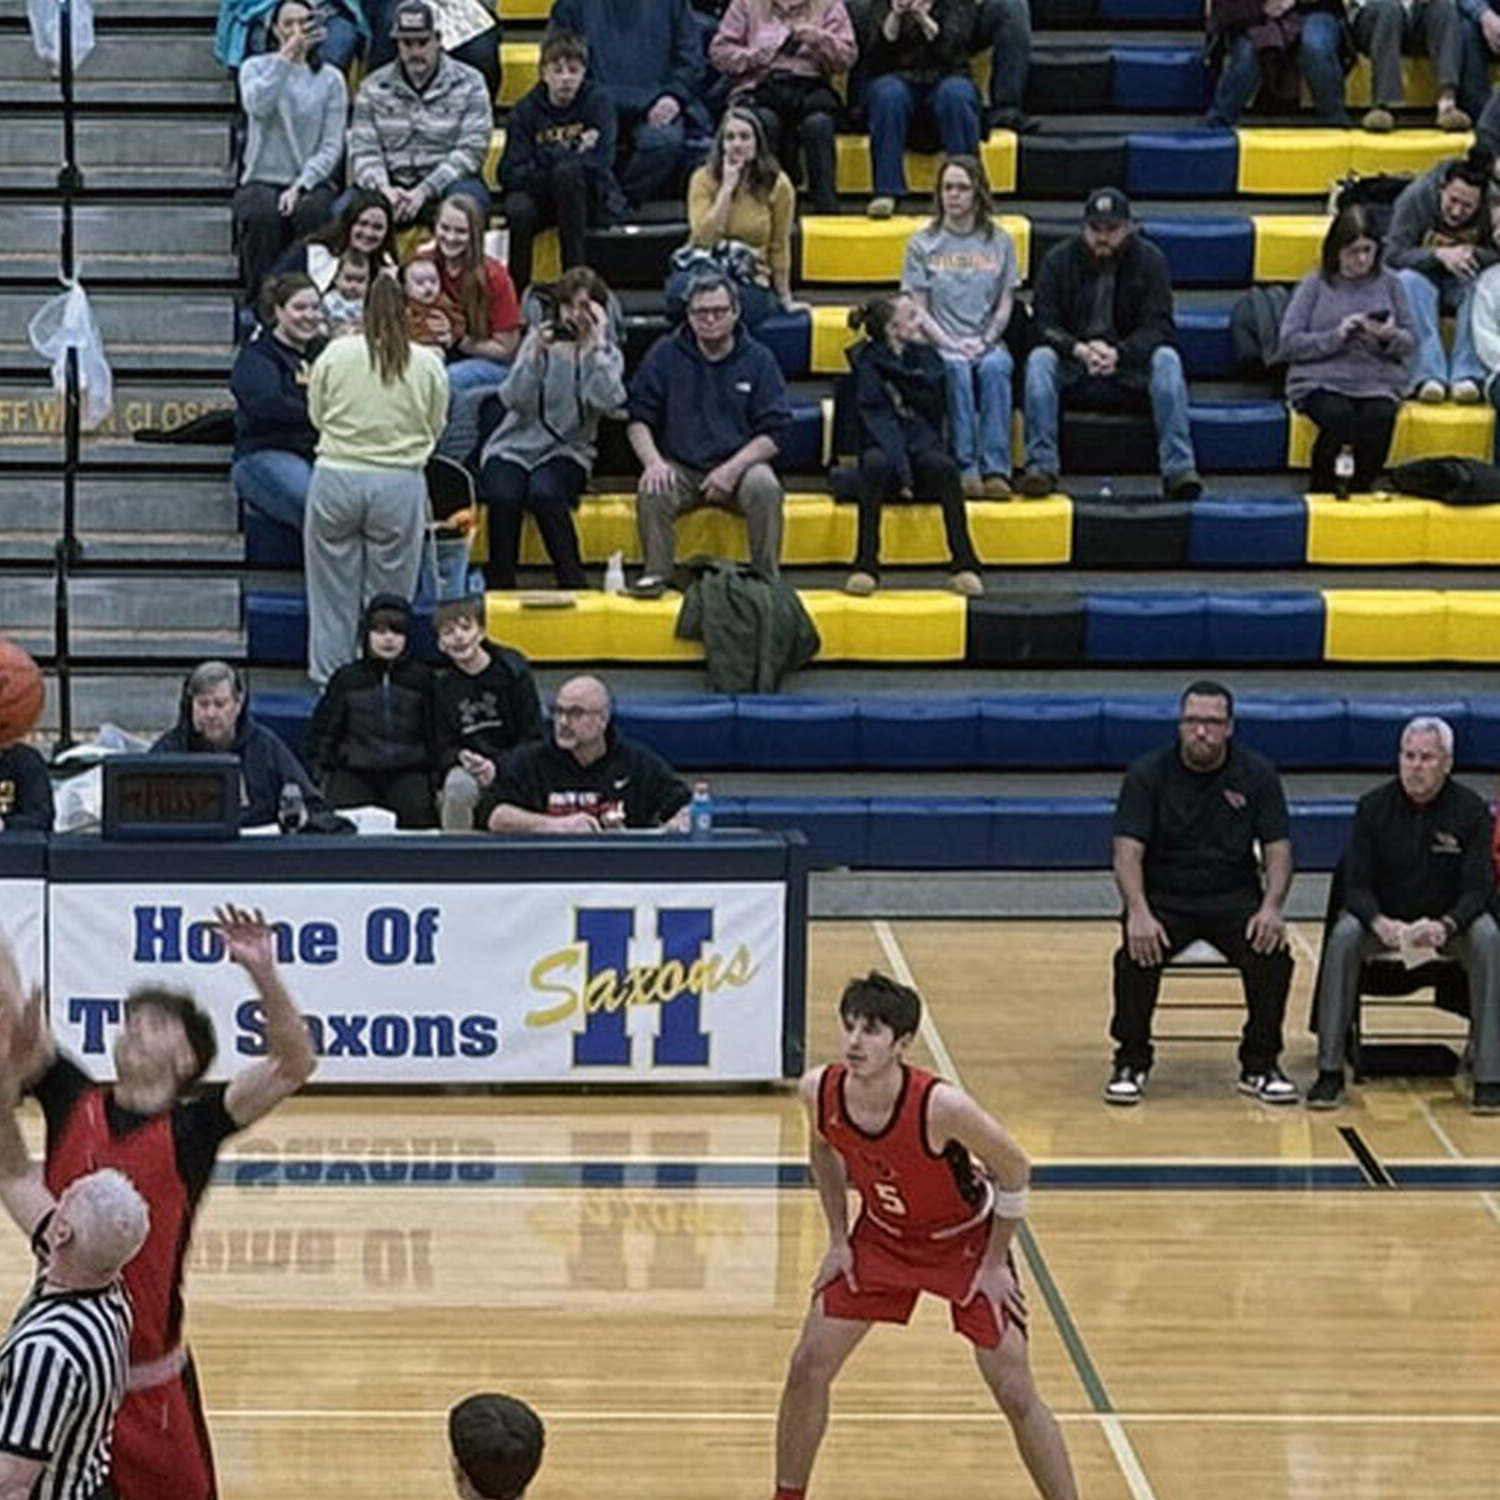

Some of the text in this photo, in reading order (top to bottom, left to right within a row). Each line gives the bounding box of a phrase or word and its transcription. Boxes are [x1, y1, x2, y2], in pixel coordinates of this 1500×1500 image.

[366, 907, 441, 965] Of
[524, 944, 760, 1027] Saxons
[872, 1182, 907, 1216] 5
